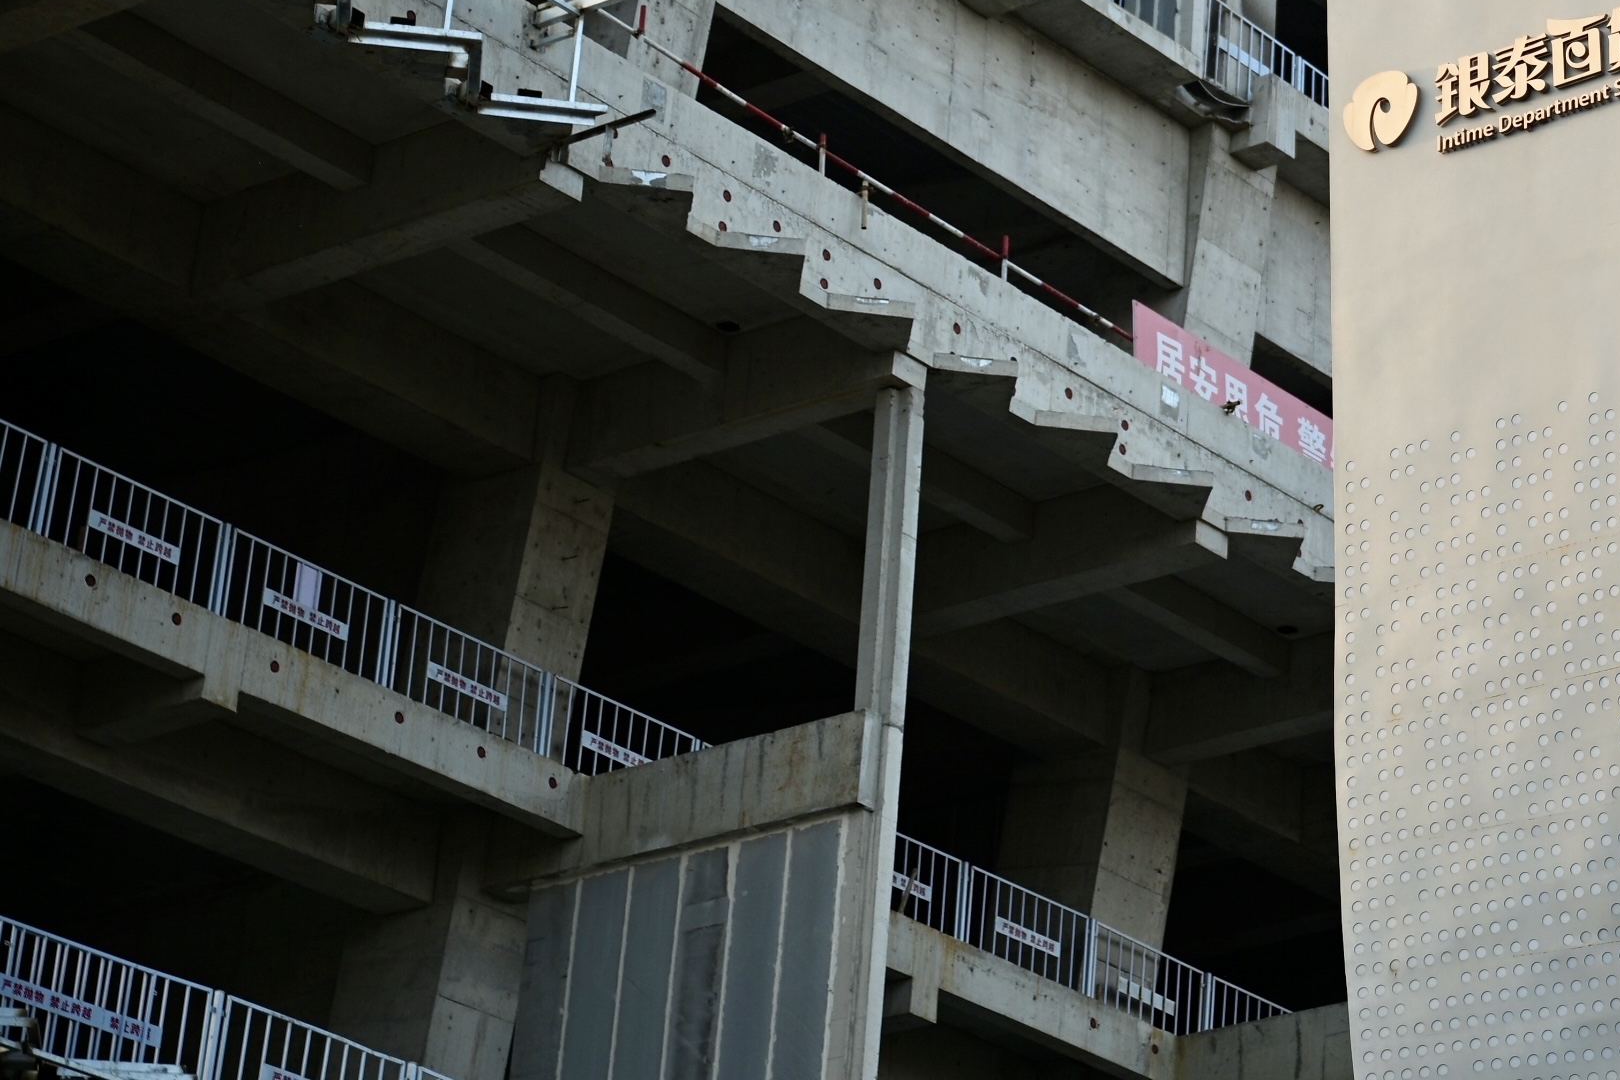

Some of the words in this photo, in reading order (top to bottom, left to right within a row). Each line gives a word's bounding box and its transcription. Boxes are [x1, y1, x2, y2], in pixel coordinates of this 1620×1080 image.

[1436, 121, 1496, 154] Intime
[1498, 83, 1611, 134] Department
[1155, 331, 1283, 440] 居安思危
[2, 978, 44, 1005] 严禁抛物
[50, 995, 92, 1020] 禁止跨越
